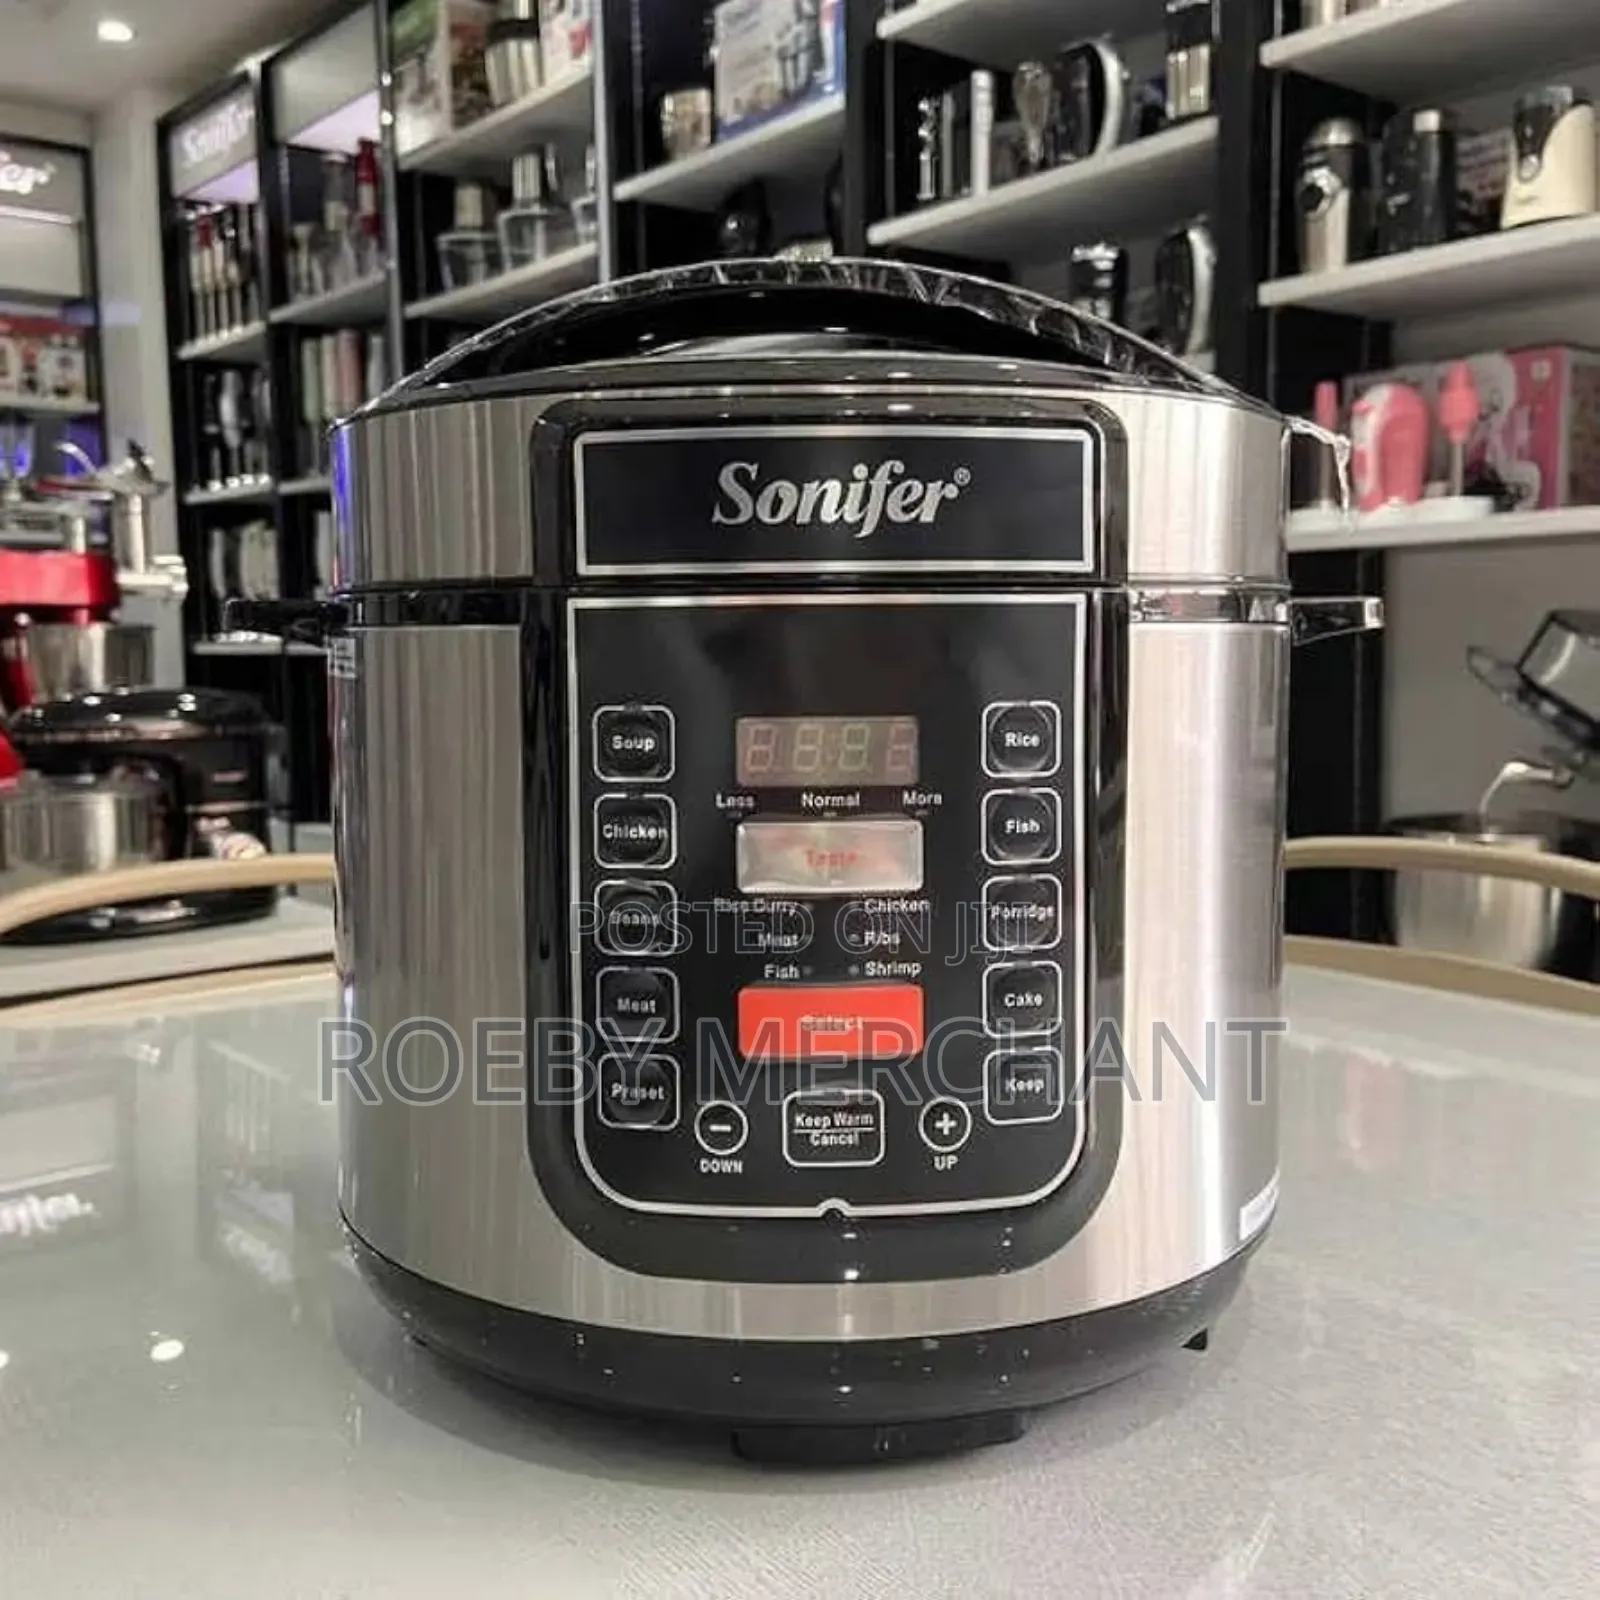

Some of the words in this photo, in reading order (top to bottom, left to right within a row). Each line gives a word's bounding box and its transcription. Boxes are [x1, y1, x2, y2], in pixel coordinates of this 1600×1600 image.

[611, 735, 656, 751] Soup
[1004, 731, 1040, 748] Rice
[715, 793, 754, 809] Less
[801, 792, 861, 808] Normal
[902, 790, 943, 806] More
[602, 825, 668, 840] Chicken
[1004, 819, 1041, 834] Fish
[863, 897, 931, 914] Chicken
[990, 904, 1056, 922] Porridge
[863, 930, 902, 945] Ribs
[763, 963, 800, 979] Fish
[863, 960, 922, 978] Shrimp
[616, 998, 656, 1014] Meat
[1004, 993, 1043, 1007] Cake
[610, 1082, 665, 1101] Preset
[1004, 1077, 1044, 1094] Keep
[795, 1112, 832, 1131] Keep
[834, 1111, 875, 1127] Warm
[809, 1131, 860, 1147] Cancel
[700, 1158, 743, 1175] DOWN
[933, 1155, 958, 1172] UP
